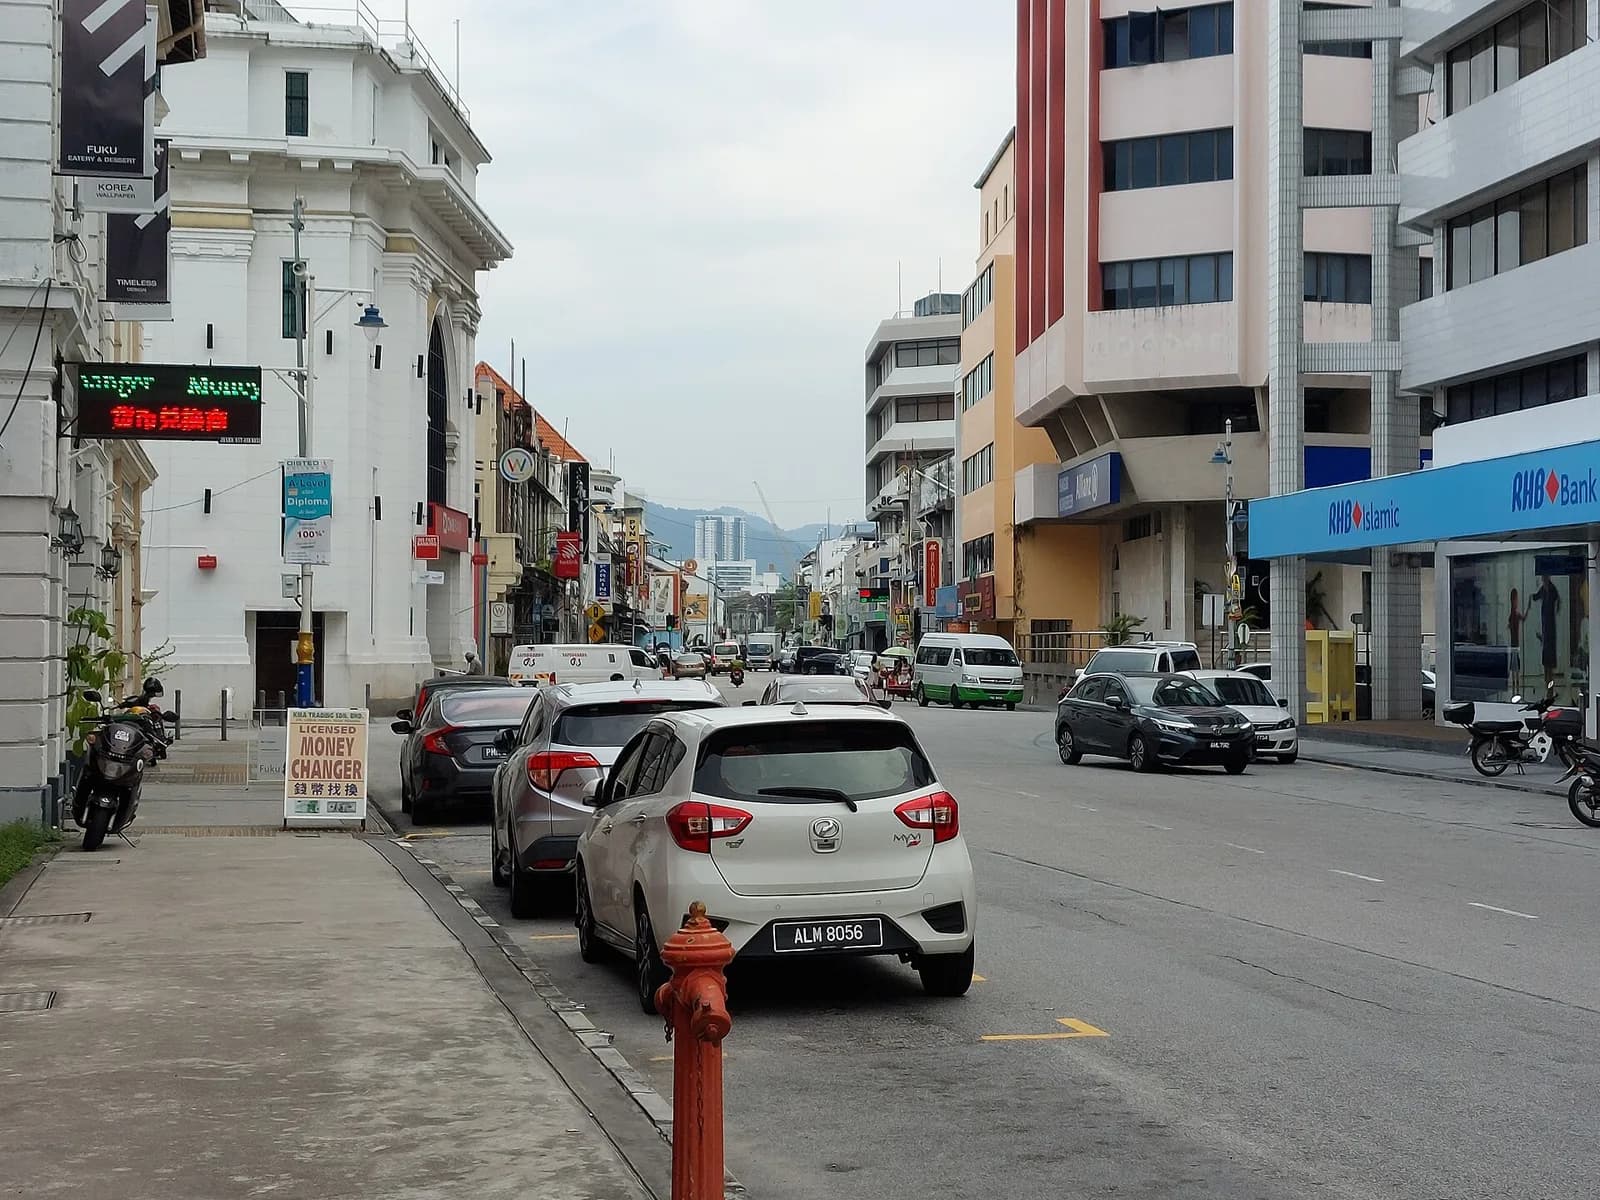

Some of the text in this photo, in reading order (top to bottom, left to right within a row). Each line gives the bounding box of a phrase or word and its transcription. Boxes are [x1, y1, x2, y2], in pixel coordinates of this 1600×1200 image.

[87, 145, 117, 155] FUKU
[104, 157, 136, 165] DESSERT
[98, 183, 134, 192] KOREA
[96, 192, 136, 200] WALLPAPER
[116, 279, 157, 288] TIMELESS
[1511, 467, 1598, 513] RHB Bank
[287, 497, 329, 509] Diploma
[1328, 498, 1400, 536] RHB Islamic
[628, 519, 637, 537] PVN
[599, 564, 607, 597] PARKING
[299, 725, 357, 735] LICENSED
[300, 736, 355, 757] MONEY
[259, 764, 281, 774] Fuku
[291, 759, 362, 780] CHANGER
[294, 782, 358, 797] 錢幣找換
[794, 924, 863, 944] ALM 8056
